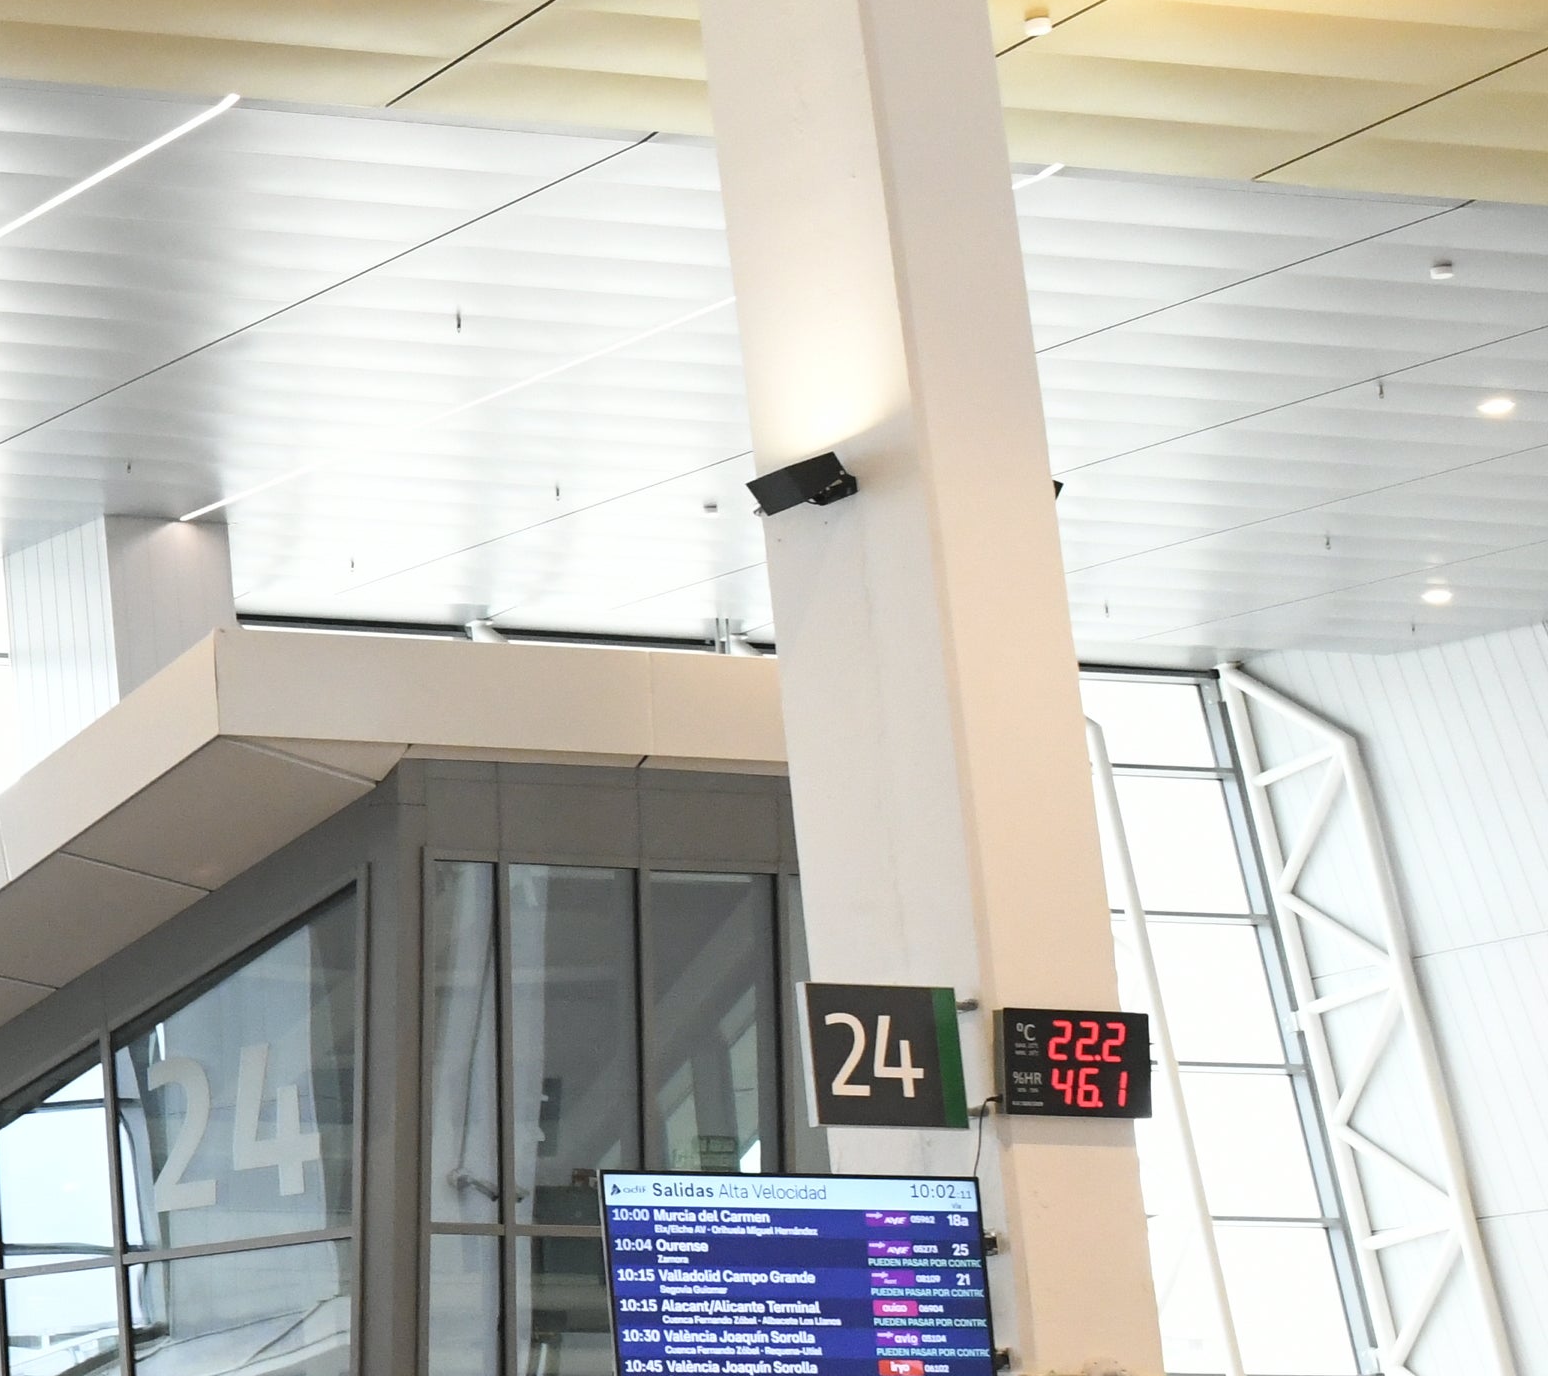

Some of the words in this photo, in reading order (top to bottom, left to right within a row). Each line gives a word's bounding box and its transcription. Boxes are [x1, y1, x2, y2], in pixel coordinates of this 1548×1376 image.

[1047, 1019, 1127, 1063] 22.2
[824, 1012, 924, 1098] 24
[1012, 1071, 1043, 1085] %HR
[1050, 1067, 1129, 1109] 46.1
[147, 1042, 321, 1213] 24
[651, 1182, 714, 1197] Salidas
[717, 1183, 748, 1198] Alta
[752, 1184, 827, 1199] Velocidad
[611, 1208, 650, 1221] 10:00
[652, 1209, 696, 1221] Murcia
[697, 1209, 719, 1222] del
[719, 1210, 770, 1222] Carmen
[946, 1214, 968, 1226] 18a
[614, 1238, 652, 1251] 10:04
[655, 1239, 709, 1252] Ourense
[951, 1243, 969, 1256] 25
[868, 1258, 901, 1266] PUEDEN
[902, 1258, 929, 1266] PASAR
[930, 1258, 947, 1266] POR
[616, 1268, 655, 1281] 10:15
[657, 1269, 721, 1282] Valladolid
[721, 1270, 768, 1285] Campo
[769, 1270, 816, 1283] Grande
[955, 1273, 970, 1285] 21
[870, 1288, 904, 1296] PUEDEN
[904, 1288, 931, 1296] PASAR
[932, 1288, 950, 1296] POR
[619, 1299, 657, 1311] 10:15
[660, 1299, 765, 1315] Alacant/Alicante
[765, 1300, 820, 1313] Terminal
[873, 1317, 906, 1326] PUEDEN
[907, 1318, 934, 1326] PASAR
[935, 1318, 952, 1326] POR
[621, 1329, 660, 1342] 10:30
[663, 1329, 718, 1342] València
[718, 1330, 769, 1345] Joaquín
[770, 1330, 815, 1343] Sorolla
[876, 1347, 909, 1356] PUEDEN
[910, 1348, 937, 1356] PASAR
[938, 1348, 955, 1356] POR
[624, 1359, 662, 1372] 10:45
[665, 1360, 720, 1372] València
[720, 1360, 772, 1375] Joaquín
[772, 1360, 818, 1373] Sorolla
